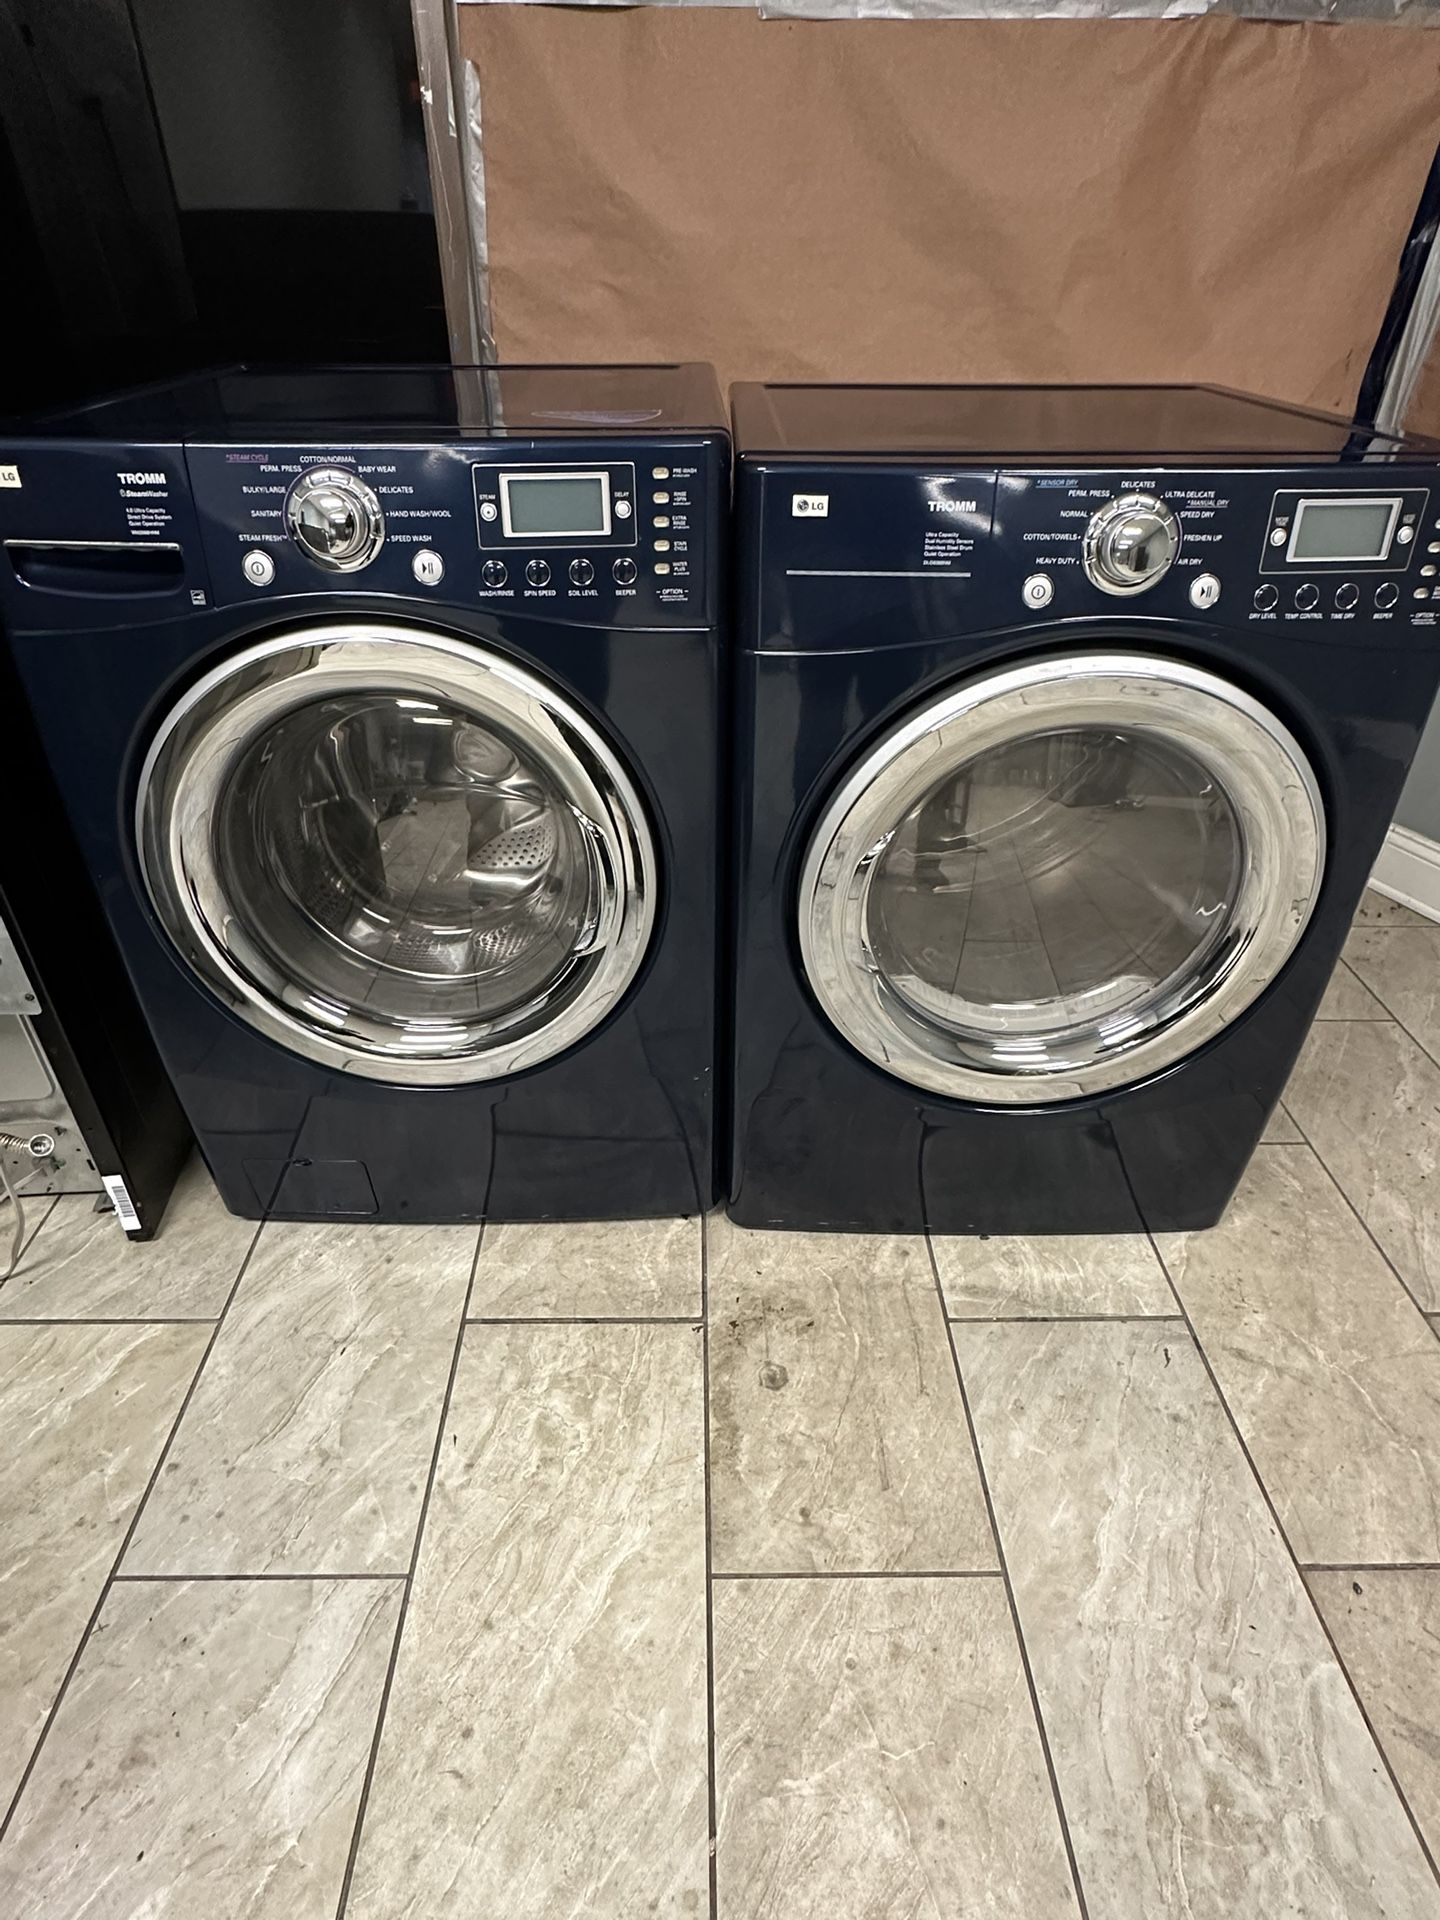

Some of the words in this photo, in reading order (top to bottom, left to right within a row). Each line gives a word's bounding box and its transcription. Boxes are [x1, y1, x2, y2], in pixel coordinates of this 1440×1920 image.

[251, 454, 269, 462] CYCLE
[3, 472, 16, 481] LG
[117, 472, 167, 485] TROMM
[1121, 481, 1156, 489] DELICATES
[243, 486, 286, 494] BULKY/LARGE
[1089, 489, 1110, 497] PRESS
[1164, 490, 1186, 498] ULTRA
[1186, 490, 1216, 499] DELICATE
[811, 502, 825, 511] LG
[927, 500, 977, 513] TROMM
[1180, 510, 1201, 519] SPEED
[1201, 510, 1215, 518] DRY
[1023, 533, 1078, 541] COTTON/TOWELS
[1183, 534, 1213, 542] FRESHEN
[1035, 557, 1057, 565] HEAVY
[479, 589, 514, 597] WASH/RINSE
